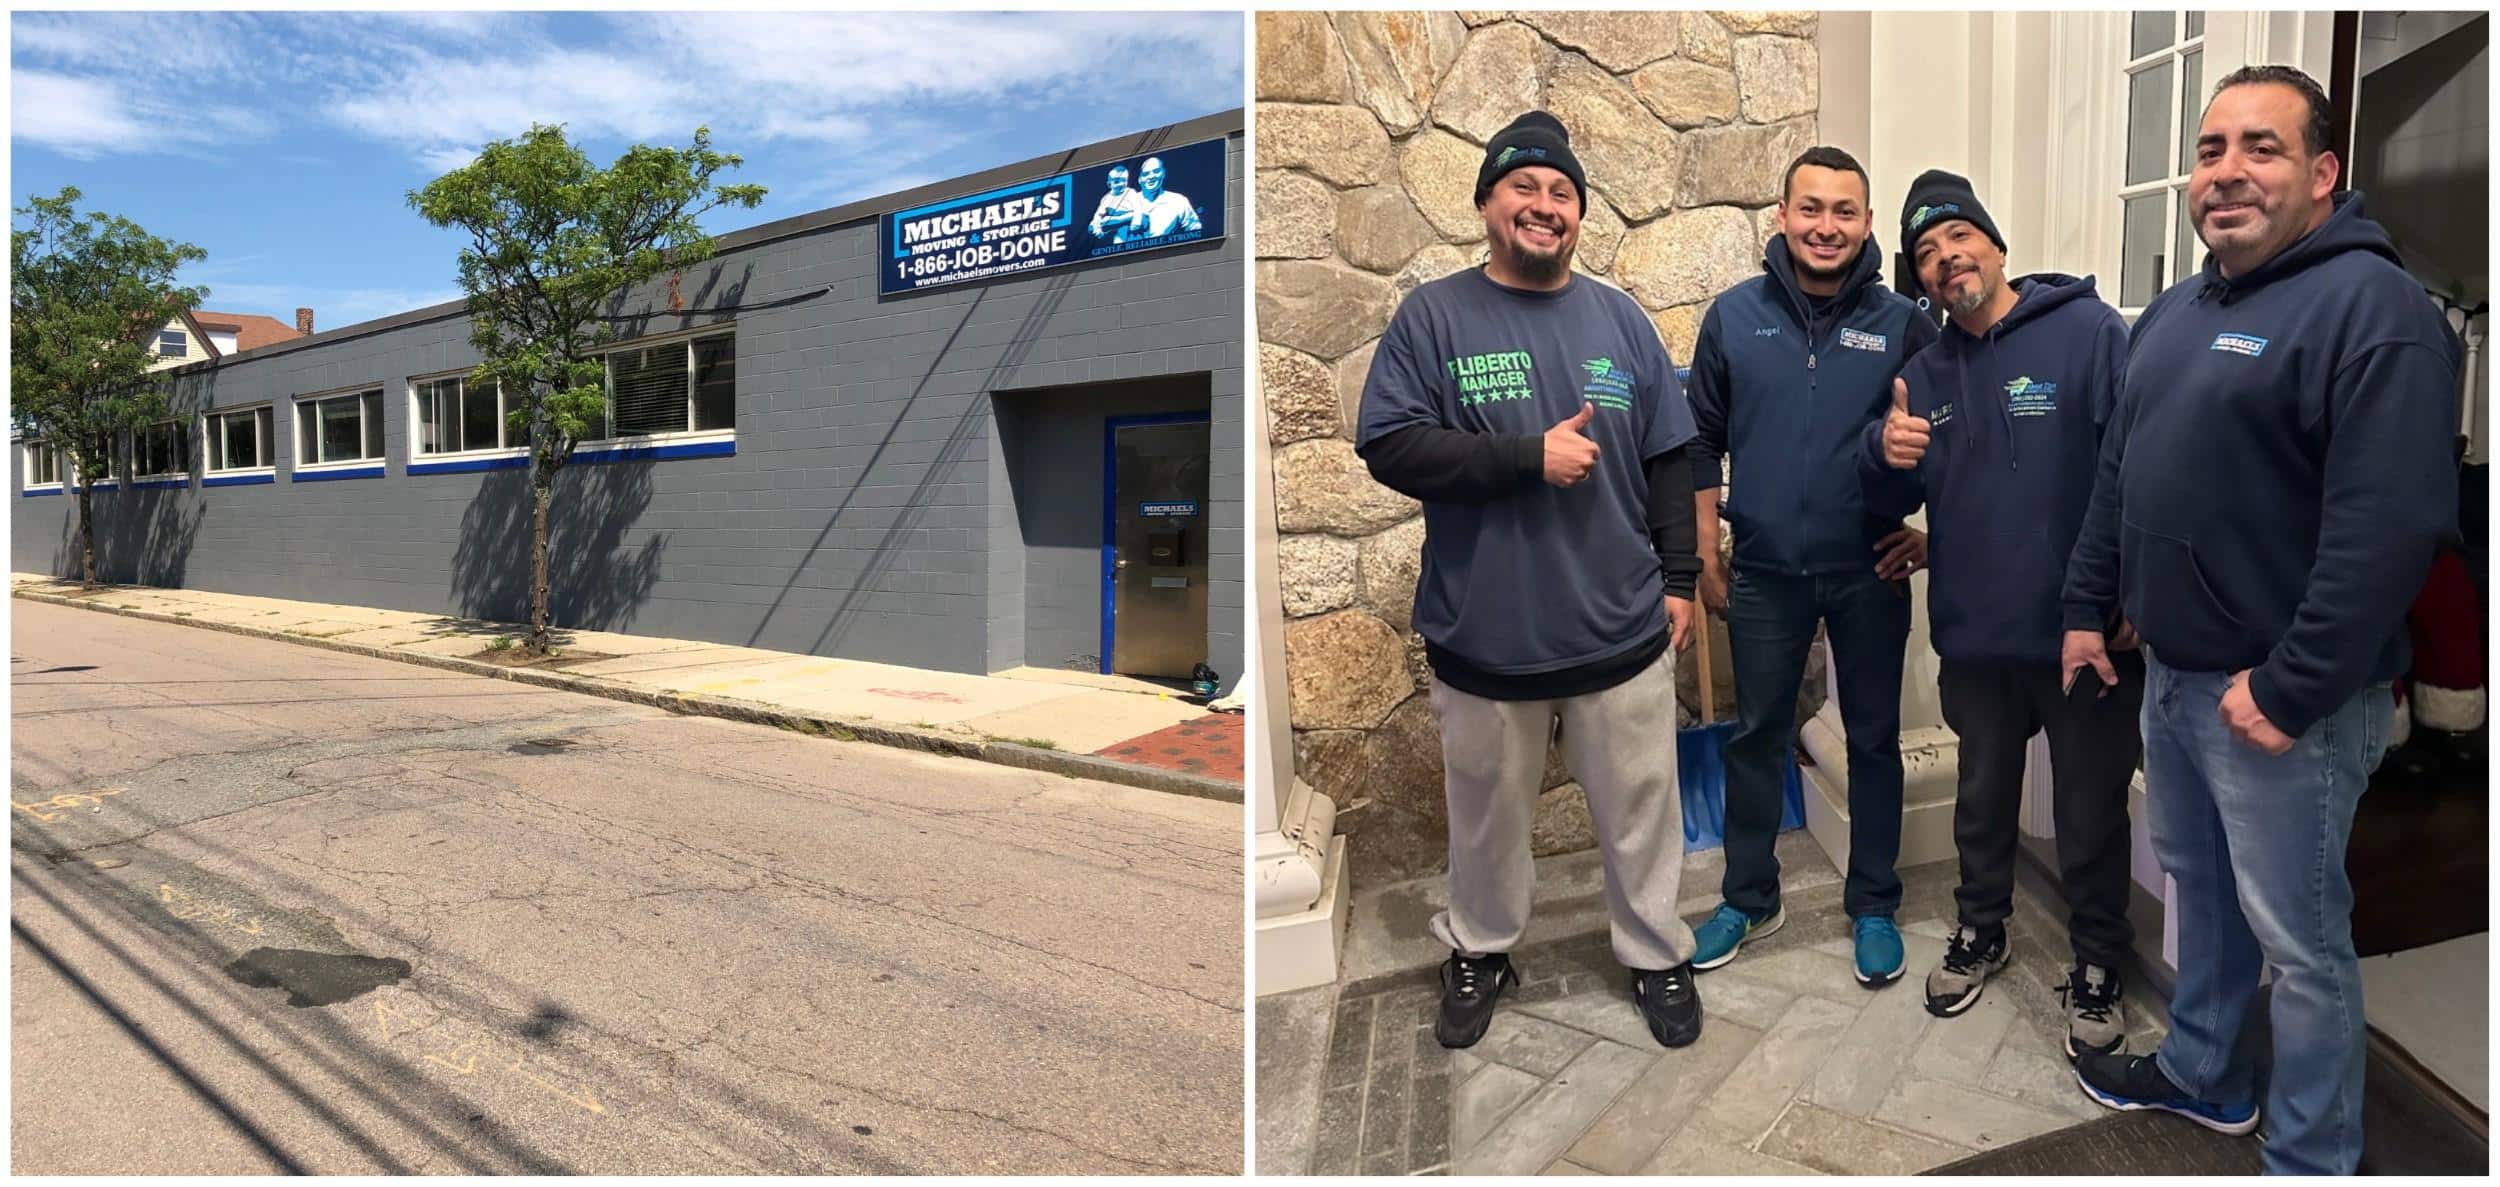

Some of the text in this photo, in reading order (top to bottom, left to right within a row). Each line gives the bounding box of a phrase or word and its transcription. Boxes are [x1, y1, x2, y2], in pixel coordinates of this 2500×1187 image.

[912, 219, 1050, 255] MOVING & STORAGE
[898, 230, 1066, 279] 1-866-JOB-DONE
[915, 258, 1045, 287] www.michaelsmovers.com
[1755, 326, 1780, 337] Angel
[1459, 371, 1527, 393] MANAGER
